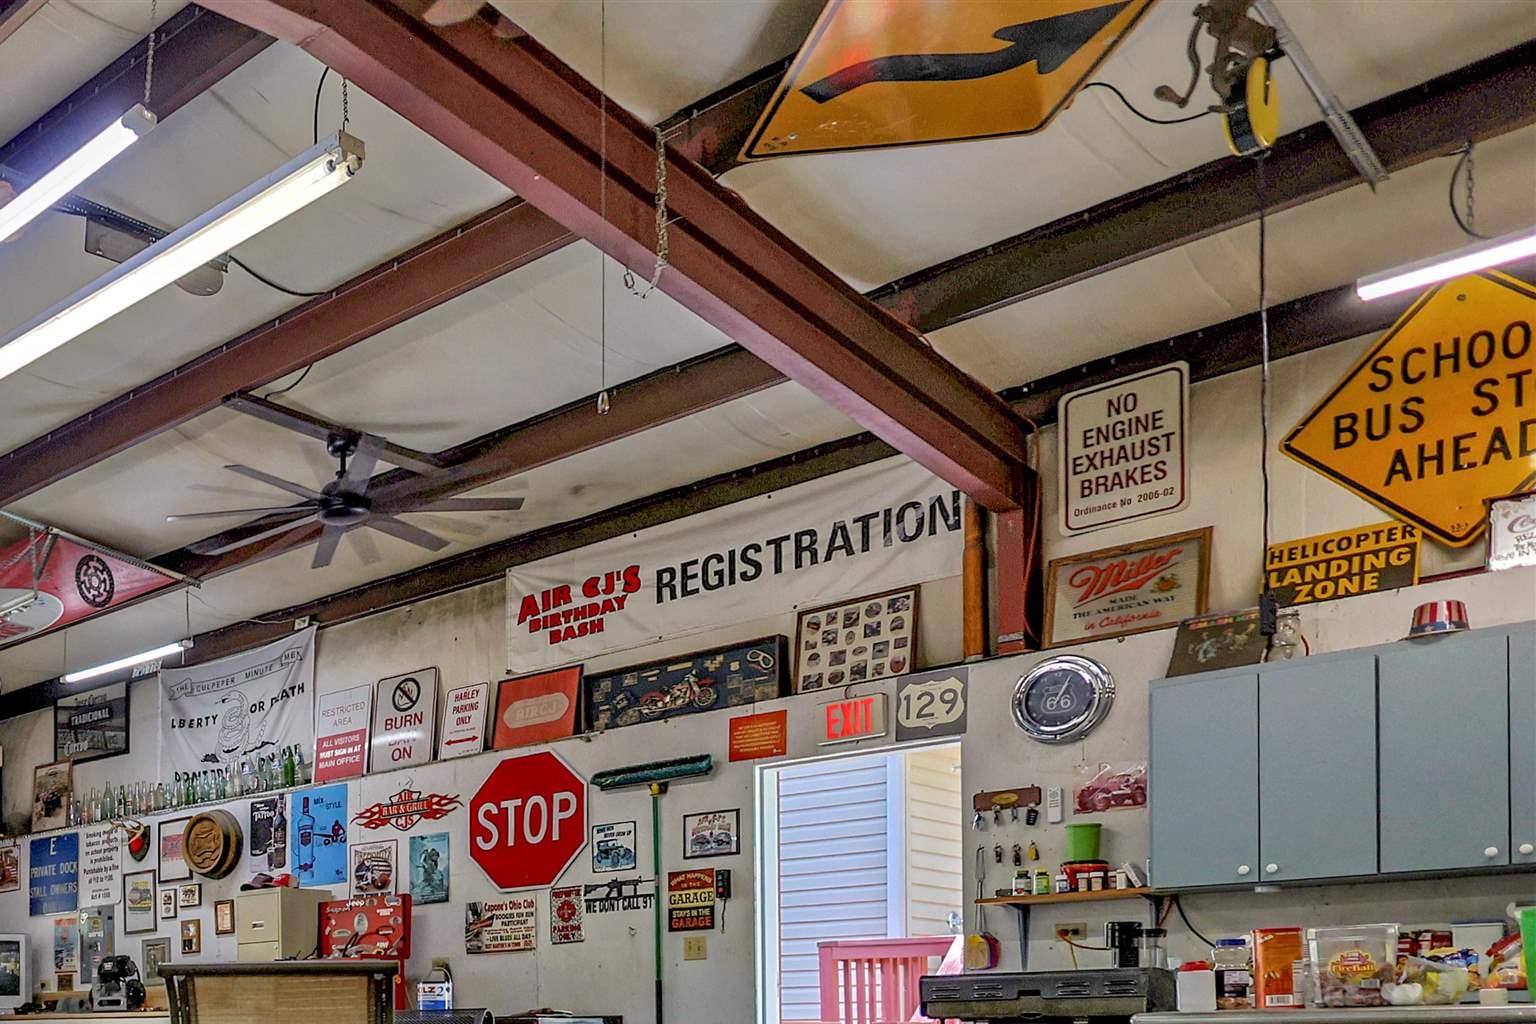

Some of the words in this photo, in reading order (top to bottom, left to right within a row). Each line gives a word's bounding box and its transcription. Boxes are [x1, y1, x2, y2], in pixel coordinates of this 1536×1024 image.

[1107, 392, 1137, 417] NO
[1334, 396, 1424, 451] BUS
[1472, 369, 1536, 416] ST
[1083, 410, 1164, 448] ENGINE
[1072, 431, 1175, 476] EXHAUST
[1080, 460, 1168, 499] BRAKES
[1074, 500, 1117, 517] Ordinance
[656, 490, 962, 604] REGISTRATION
[1269, 524, 1418, 565] HELICOPTER
[1068, 547, 1184, 603] Miller
[1269, 547, 1412, 588] LANDING
[517, 584, 572, 626] AIR
[583, 565, 642, 599] CJ'S
[1295, 572, 1380, 603] ZONE
[528, 594, 628, 633] BIRTHDAY
[549, 618, 605, 645] BASH
[245, 664, 273, 679] MINUTE
[454, 688, 480, 701] HARLEY
[1046, 694, 1071, 711] 66
[250, 701, 265, 714] OR
[322, 702, 366, 718] RESTRICTED
[452, 701, 479, 714] PARKING
[903, 687, 960, 721] 129
[333, 717, 352, 727] AREA
[384, 711, 424, 732] BURN
[456, 715, 472, 726] ONLY
[825, 697, 875, 739] EXIT
[322, 739, 334, 748] ALL
[334, 734, 360, 746] VISITORS
[319, 759, 335, 769] MAIN
[336, 755, 361, 767] OFFICE
[391, 746, 413, 762] ON
[253, 811, 274, 822] TATTOO
[382, 805, 395, 817] BAR
[476, 791, 577, 851] STOP
[50, 838, 57, 855] E
[31, 864, 56, 878] PRIVATE
[60, 861, 78, 874] DOCK
[346, 900, 364, 908] Jeep
[484, 902, 508, 913] Capone's
[509, 900, 522, 910] Ohio
[523, 899, 534, 908] Club
[586, 901, 597, 913] WE
[622, 897, 641, 910] CALL
[669, 890, 714, 905] GARAGE
[672, 909, 690, 918] STAYS
[691, 909, 698, 917] IN
[699, 908, 711, 916] THE
[672, 917, 712, 928] GARAGE
